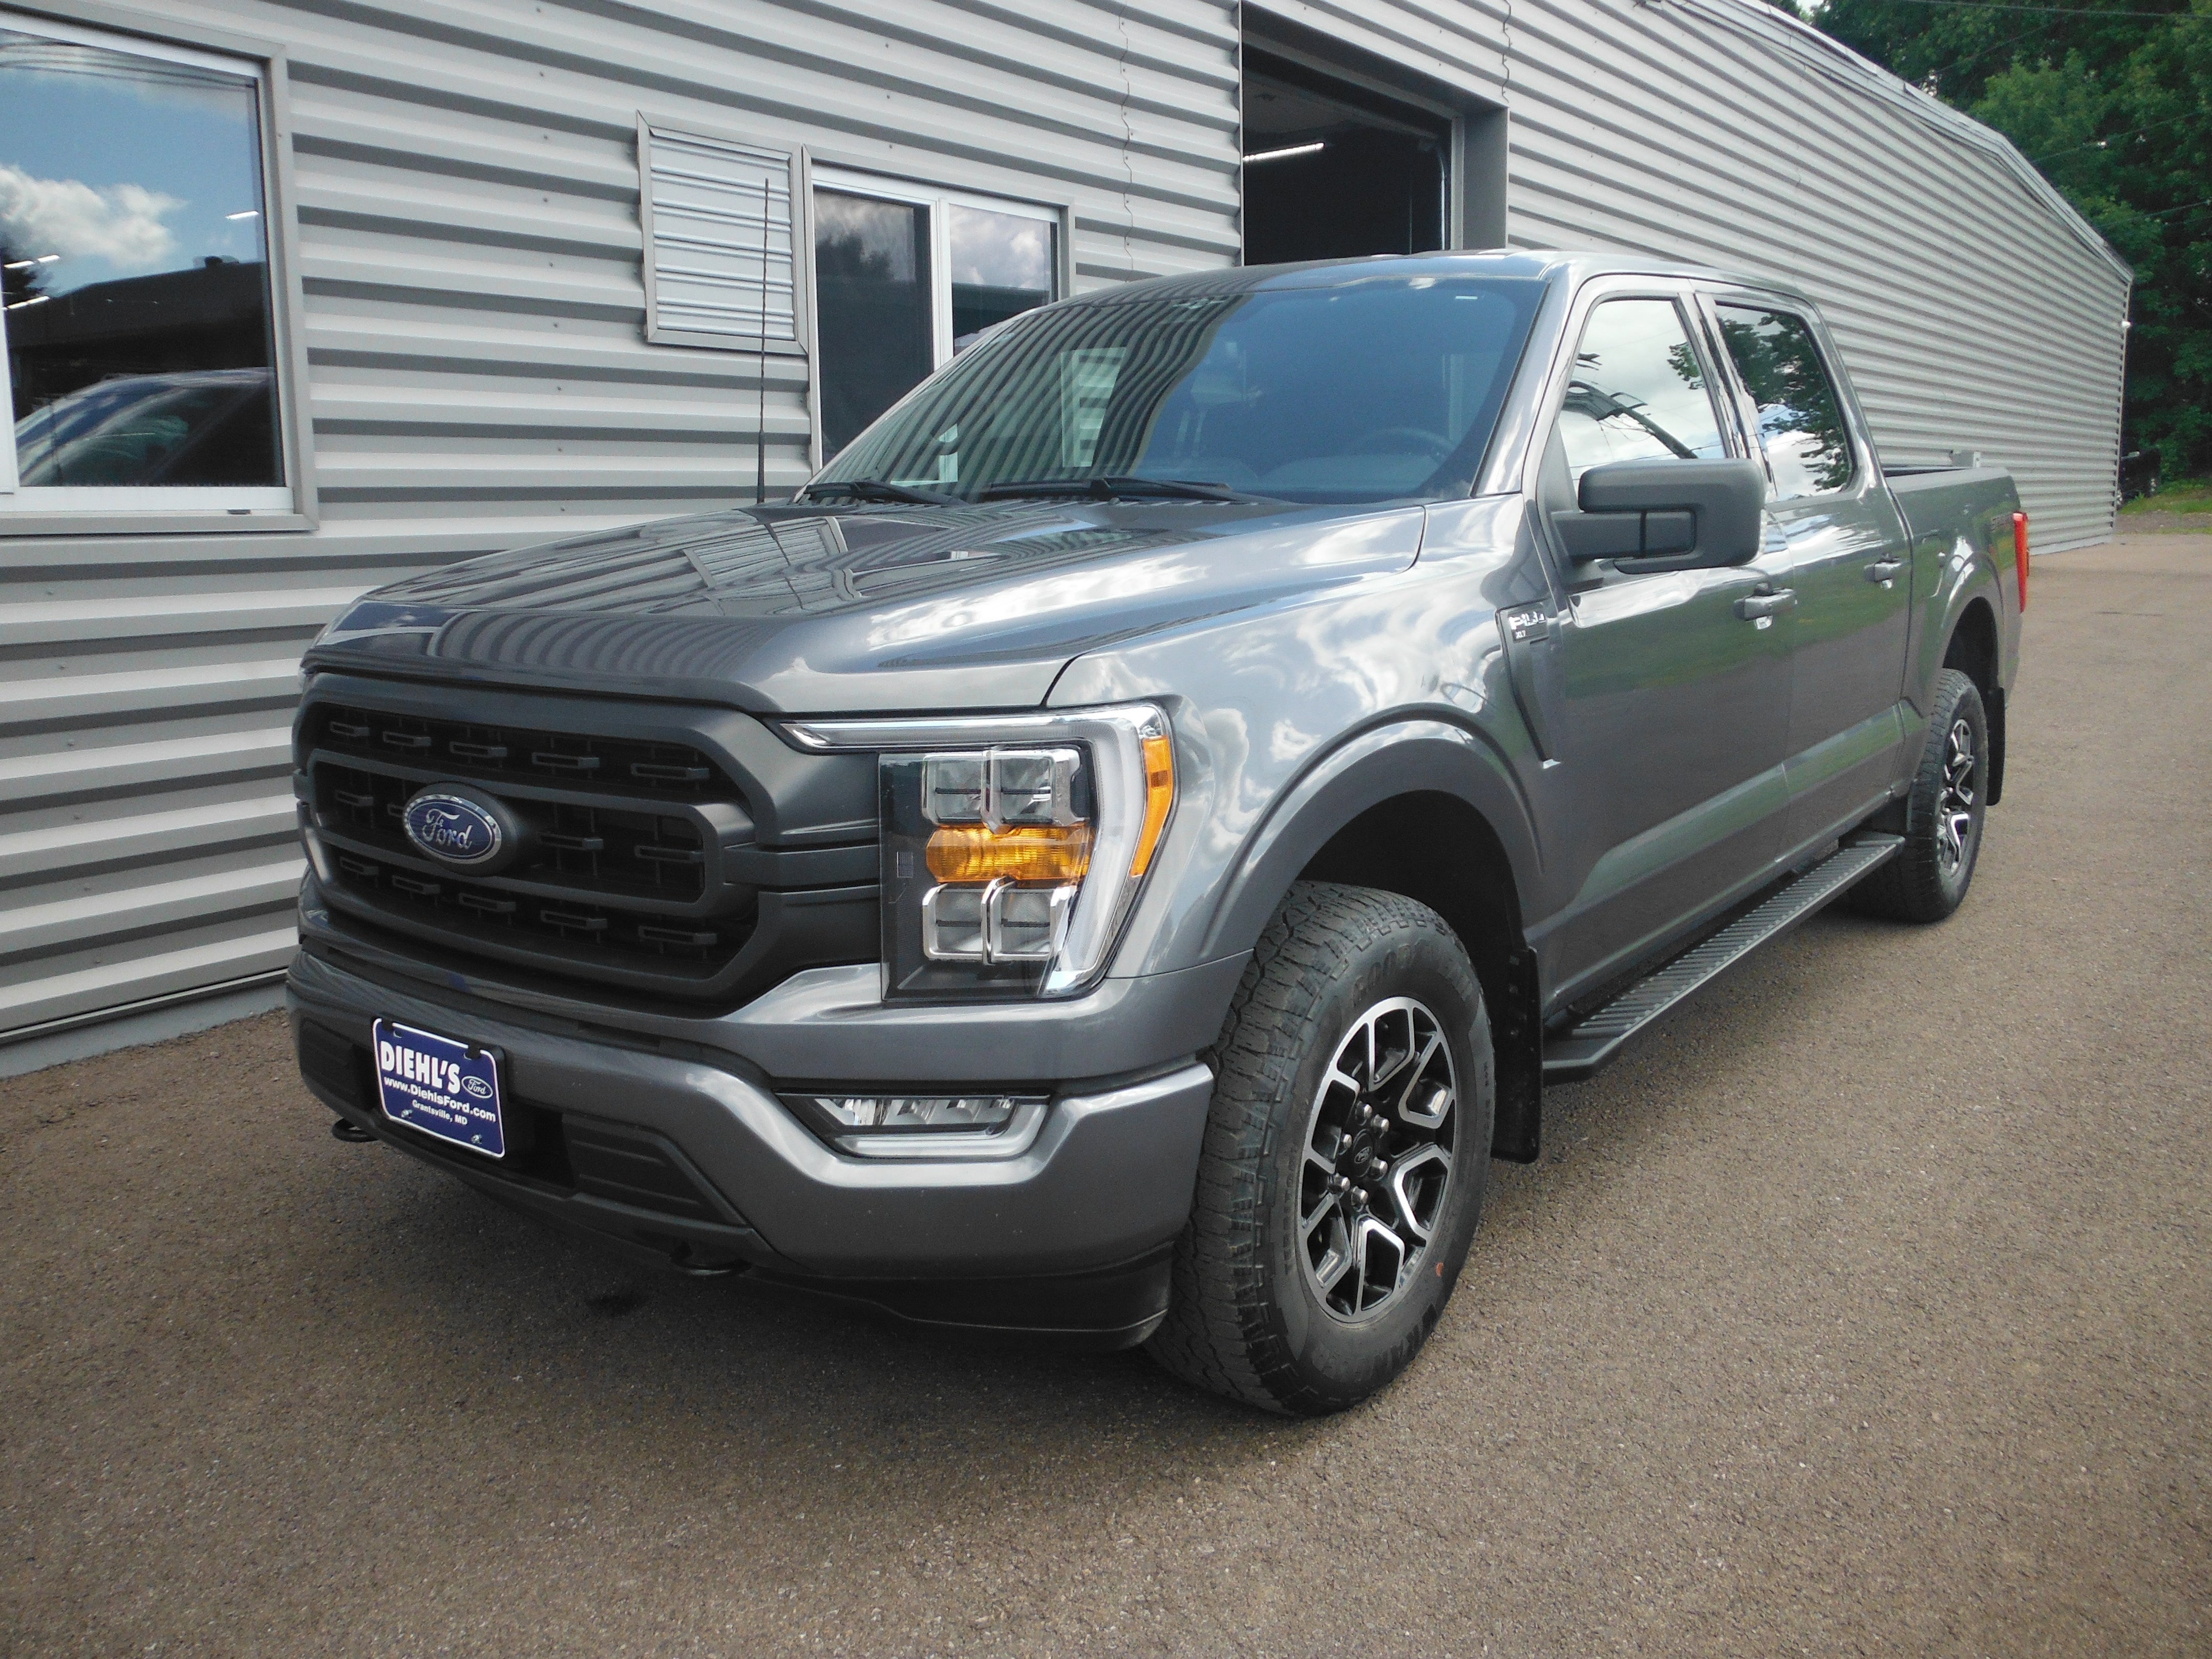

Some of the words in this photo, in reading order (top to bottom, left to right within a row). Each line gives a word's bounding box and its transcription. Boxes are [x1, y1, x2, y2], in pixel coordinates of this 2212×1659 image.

[422, 808, 473, 849] Ford
[380, 1040, 461, 1094] DIEHL'S
[467, 1078, 486, 1095] Ford
[384, 1076, 496, 1122] www.DiehlsFord.com
[412, 1099, 454, 1123] Grantsville,
[454, 1114, 469, 1125] MD
